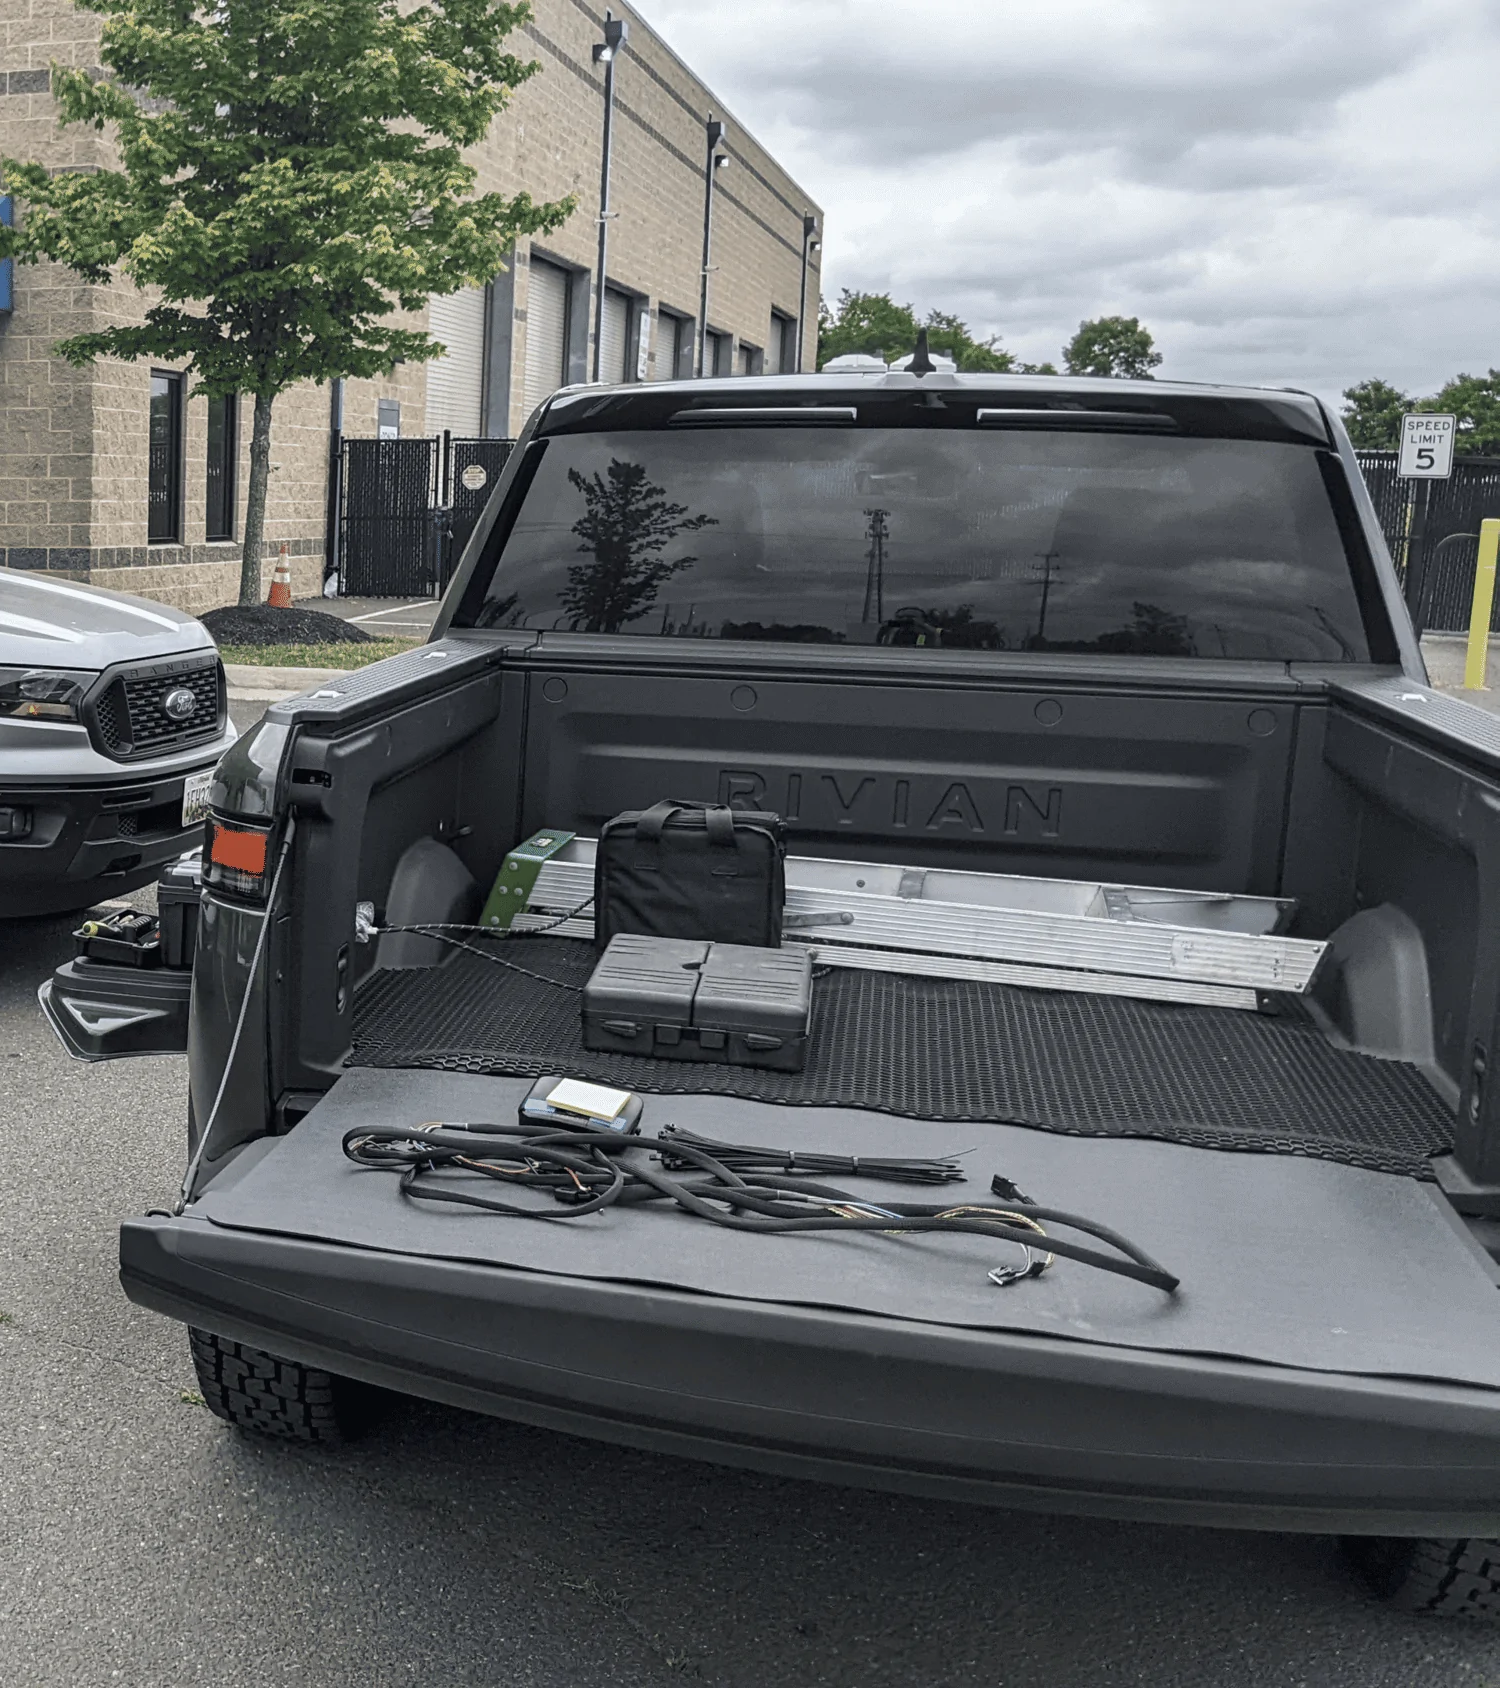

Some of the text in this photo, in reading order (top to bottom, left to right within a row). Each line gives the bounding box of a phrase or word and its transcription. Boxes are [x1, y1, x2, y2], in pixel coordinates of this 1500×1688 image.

[1407, 421, 1451, 431] SPEED
[1410, 434, 1444, 444] LIMIT
[1415, 448, 1435, 470] 5
[718, 769, 1063, 837] RIVIAN
